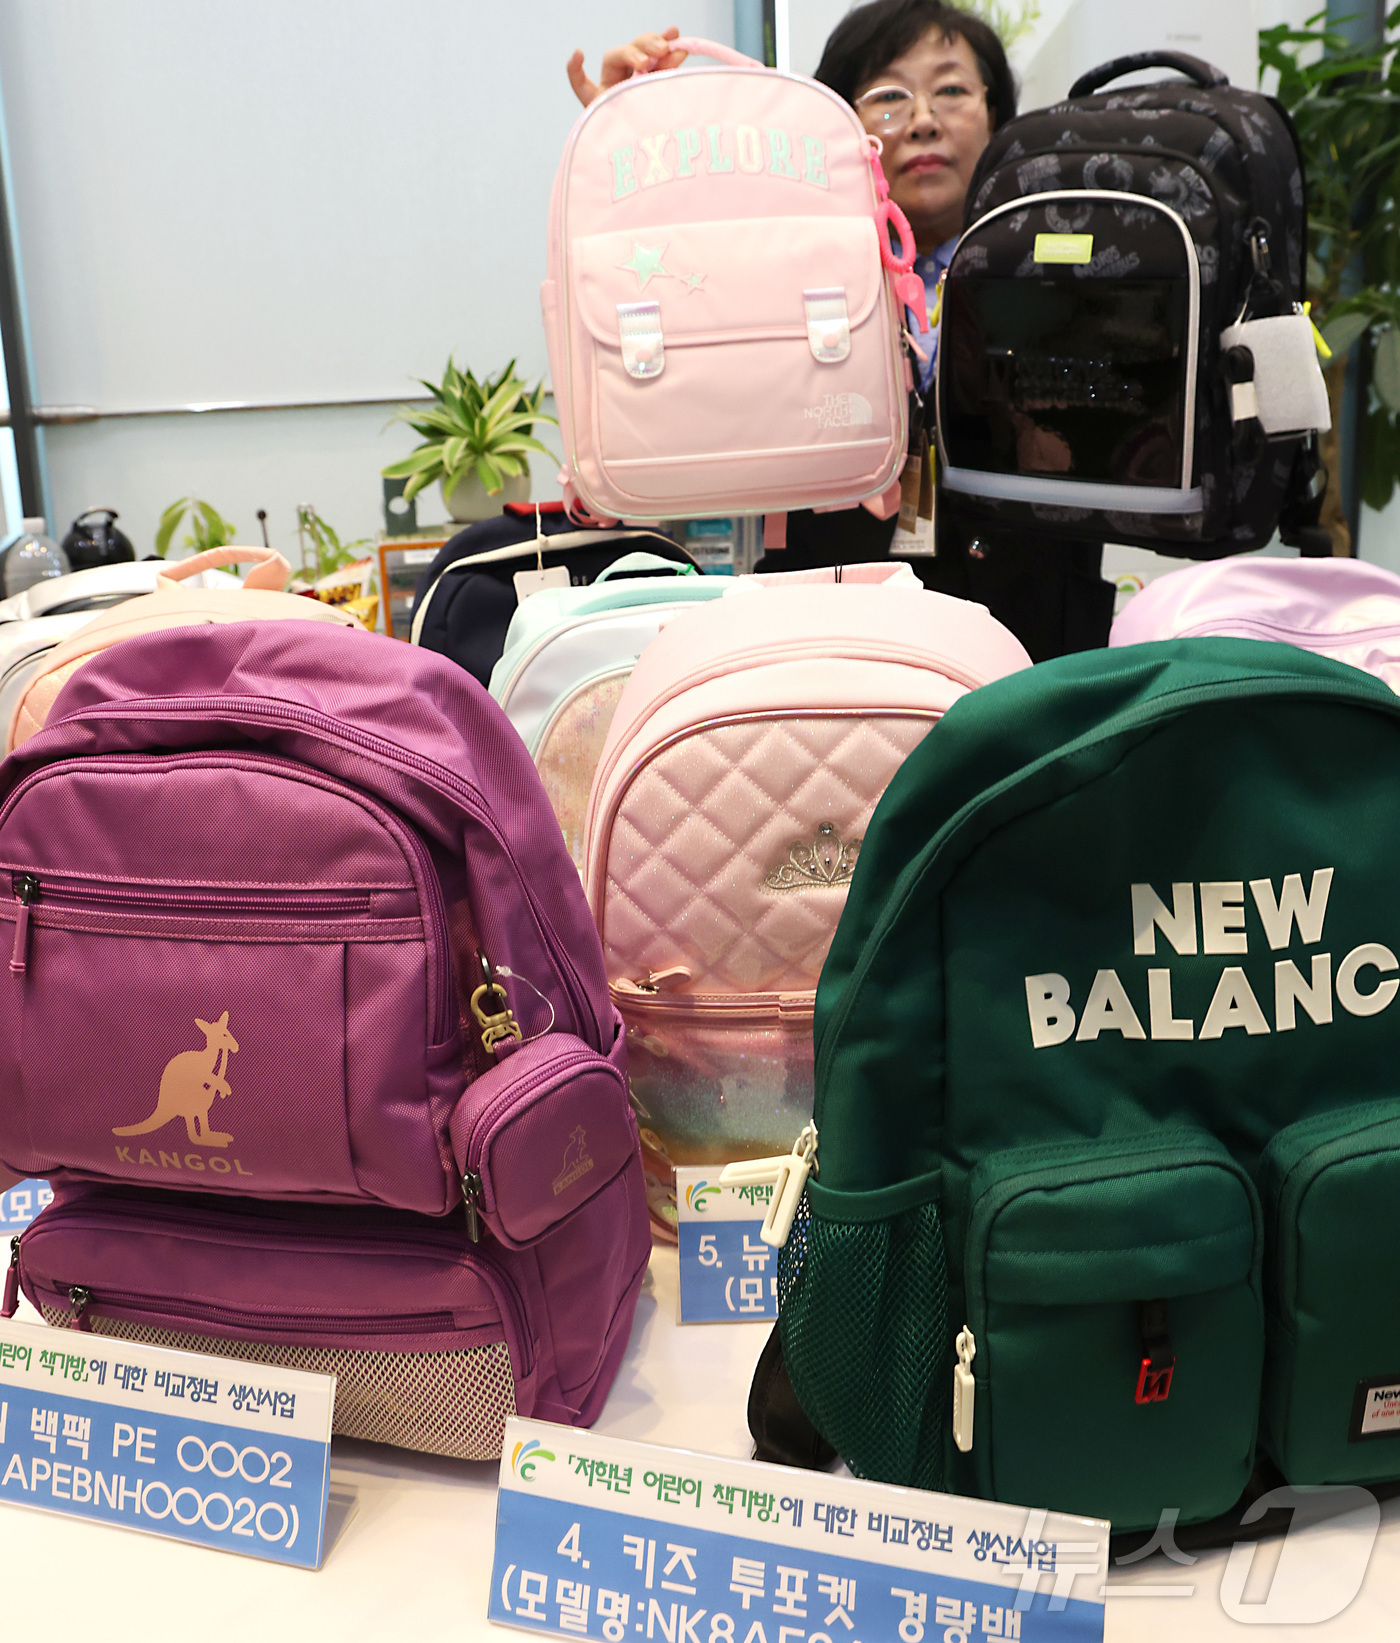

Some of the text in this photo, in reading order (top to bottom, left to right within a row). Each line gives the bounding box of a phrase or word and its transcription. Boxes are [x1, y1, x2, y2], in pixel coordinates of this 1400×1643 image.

[610, 123, 830, 203] EXPLORE
[803, 405, 850, 419] NORTH
[817, 416, 849, 429] FACE
[823, 393, 848, 407] THE
[1131, 867, 1334, 956] NEW
[1025, 942, 1400, 1049] BALANC
[114, 1145, 253, 1176] KANGOL
[698, 1235, 770, 1272] 5. 뉴
[0, 1342, 33, 1372] 린이
[113, 1363, 148, 1393] 대한
[154, 1370, 219, 1404] 비교정보
[227, 1383, 297, 1419] 생산사업
[30, 1407, 92, 1461] 백팩
[112, 1422, 157, 1465] PE
[643, 1471, 702, 1508] 어린이
[813, 1502, 858, 1537] 대한
[867, 1511, 954, 1553] 비교정보
[966, 1528, 1057, 1572] 생산사업
[557, 1522, 1022, 1643] 4. 키즈 투포켓 경량백
